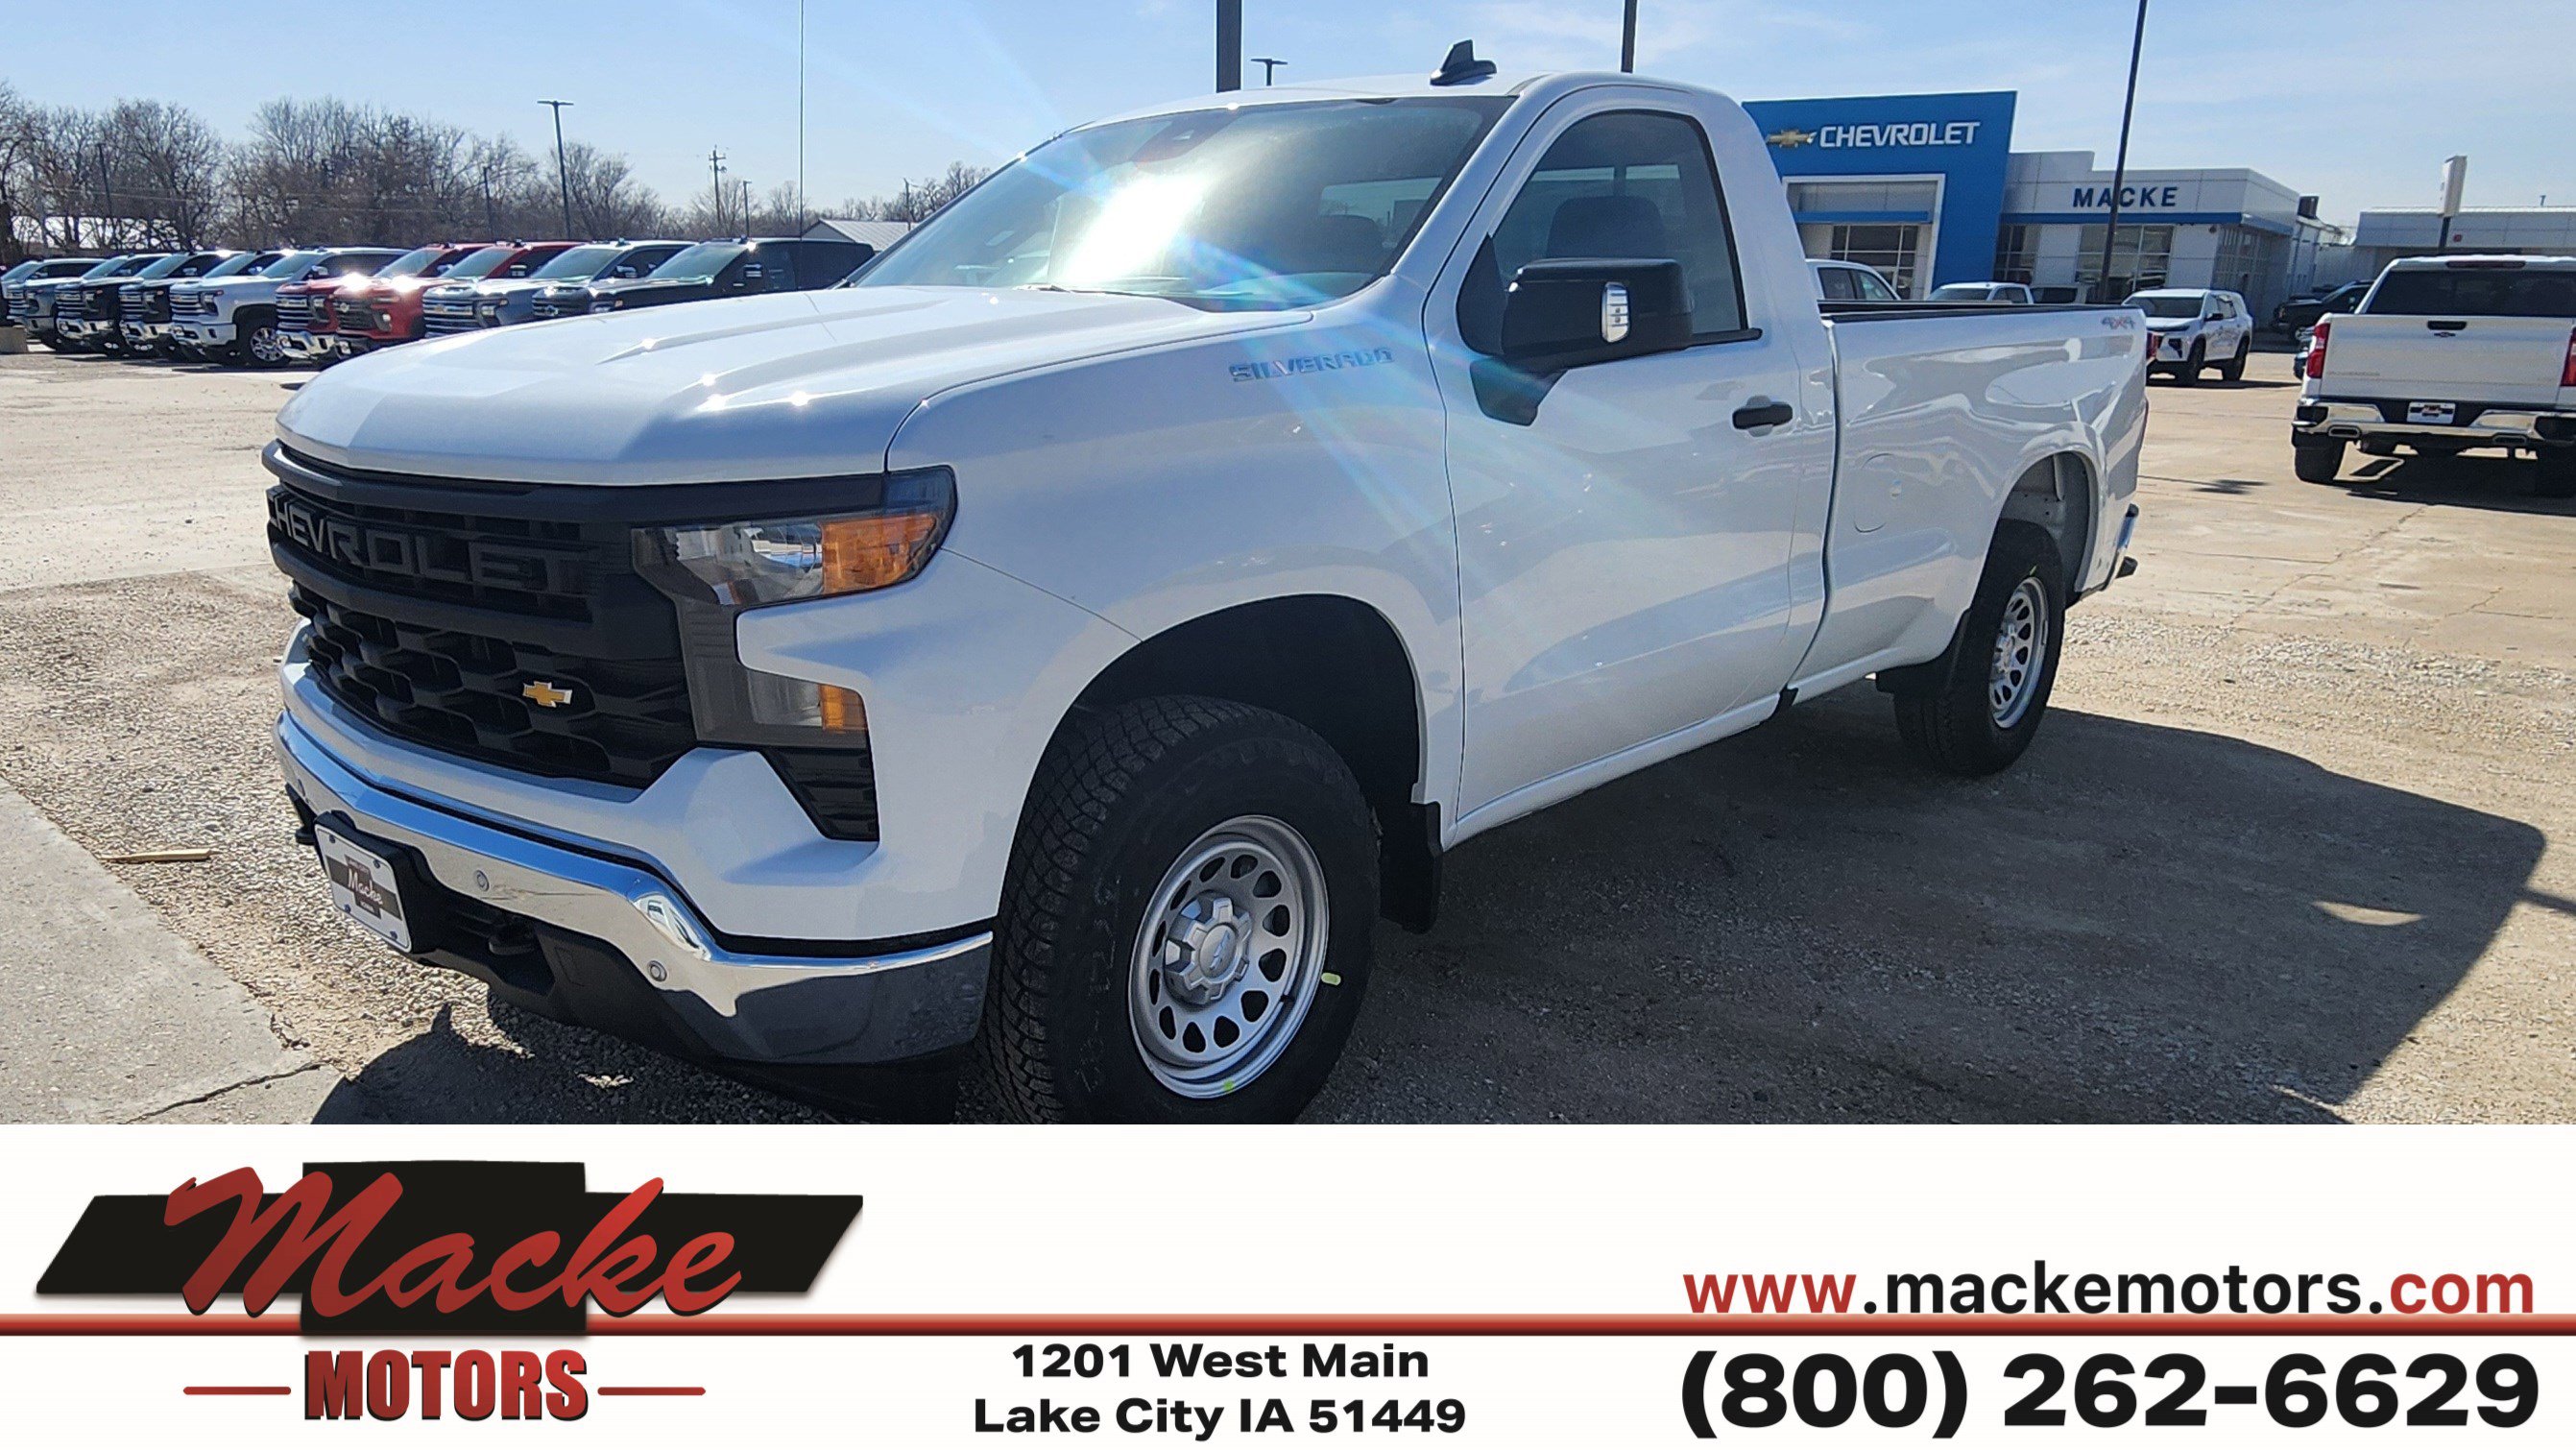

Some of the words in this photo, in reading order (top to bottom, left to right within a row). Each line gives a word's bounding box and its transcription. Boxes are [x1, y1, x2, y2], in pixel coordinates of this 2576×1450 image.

[1819, 121, 1981, 148] CHEVROLET
[2073, 185, 2178, 208] MACKE
[1229, 347, 1394, 382] SILVERADO
